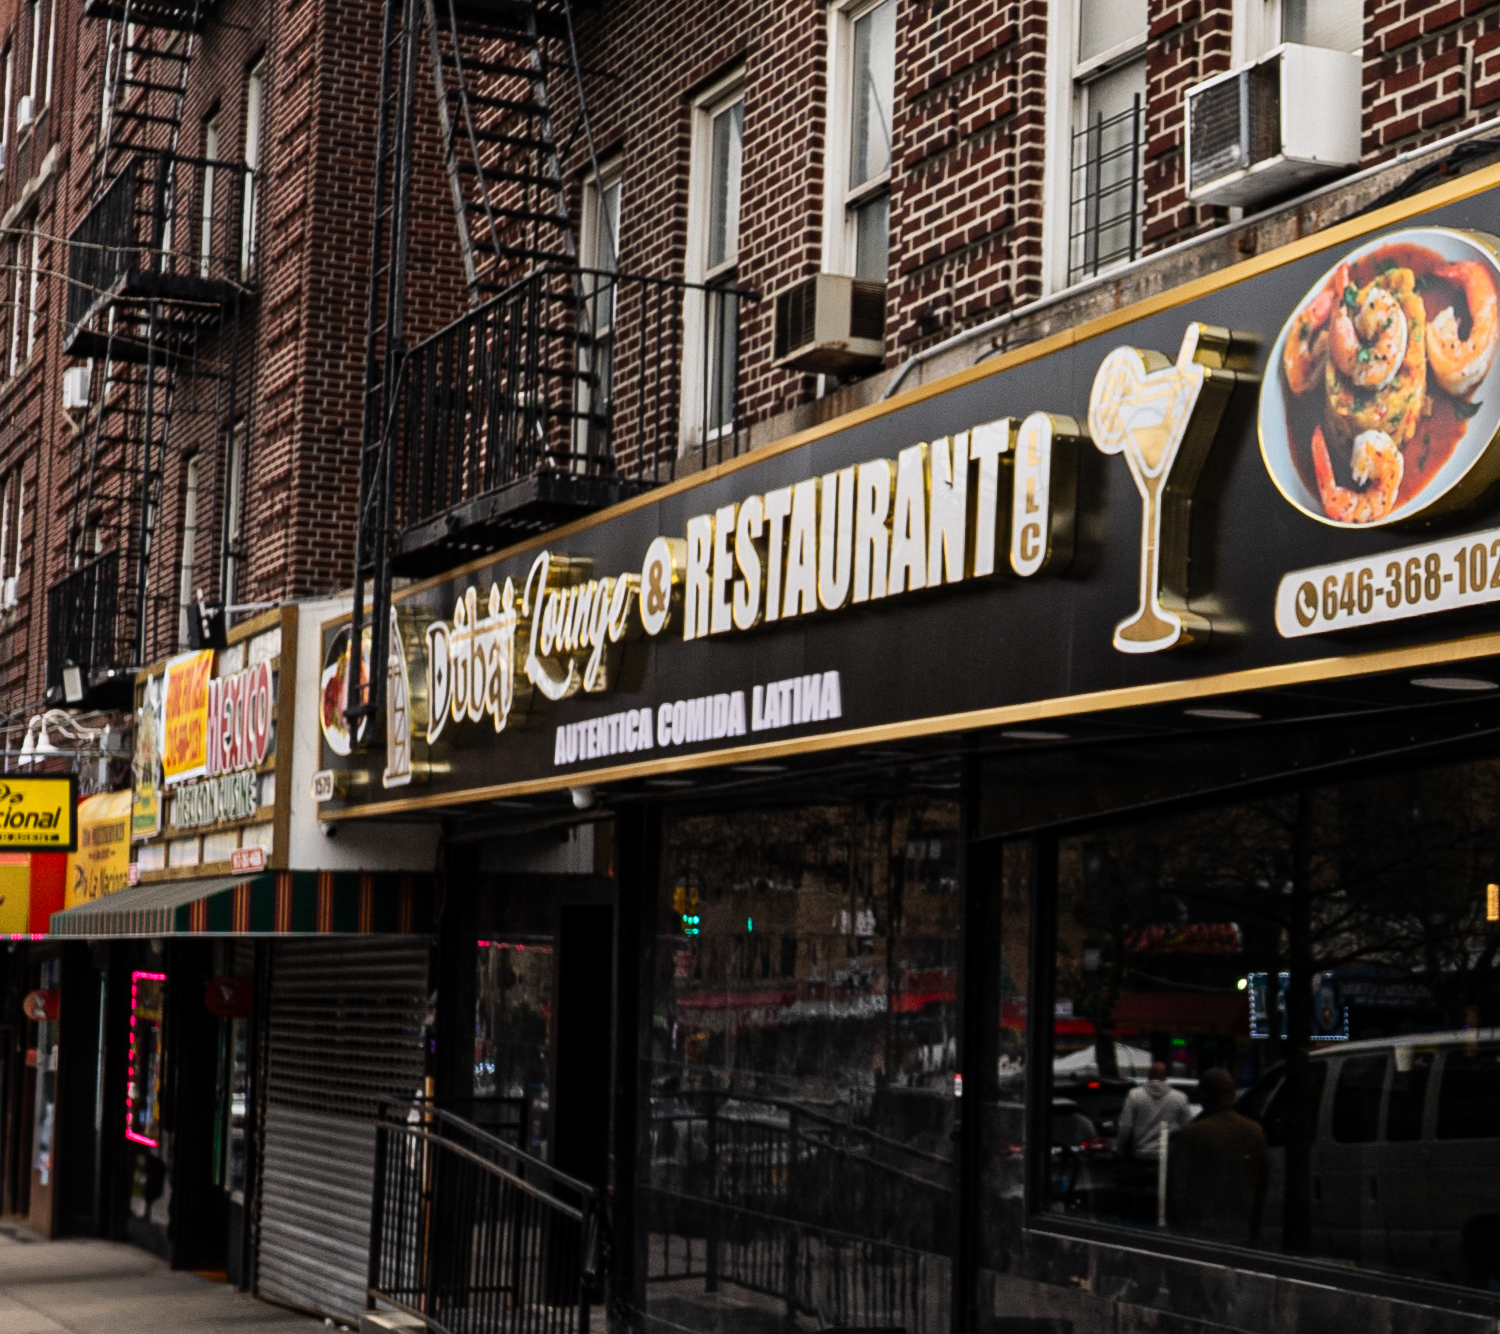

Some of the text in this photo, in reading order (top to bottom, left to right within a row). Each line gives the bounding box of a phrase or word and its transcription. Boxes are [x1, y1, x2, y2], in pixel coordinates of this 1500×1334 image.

[1019, 428, 1042, 563] LLC
[426, 576, 517, 745] Dubai
[523, 550, 634, 700] Lounge
[682, 418, 1011, 642] RESTAURANT
[554, 670, 842, 766] AUTENTICA COMIDA LATINA
